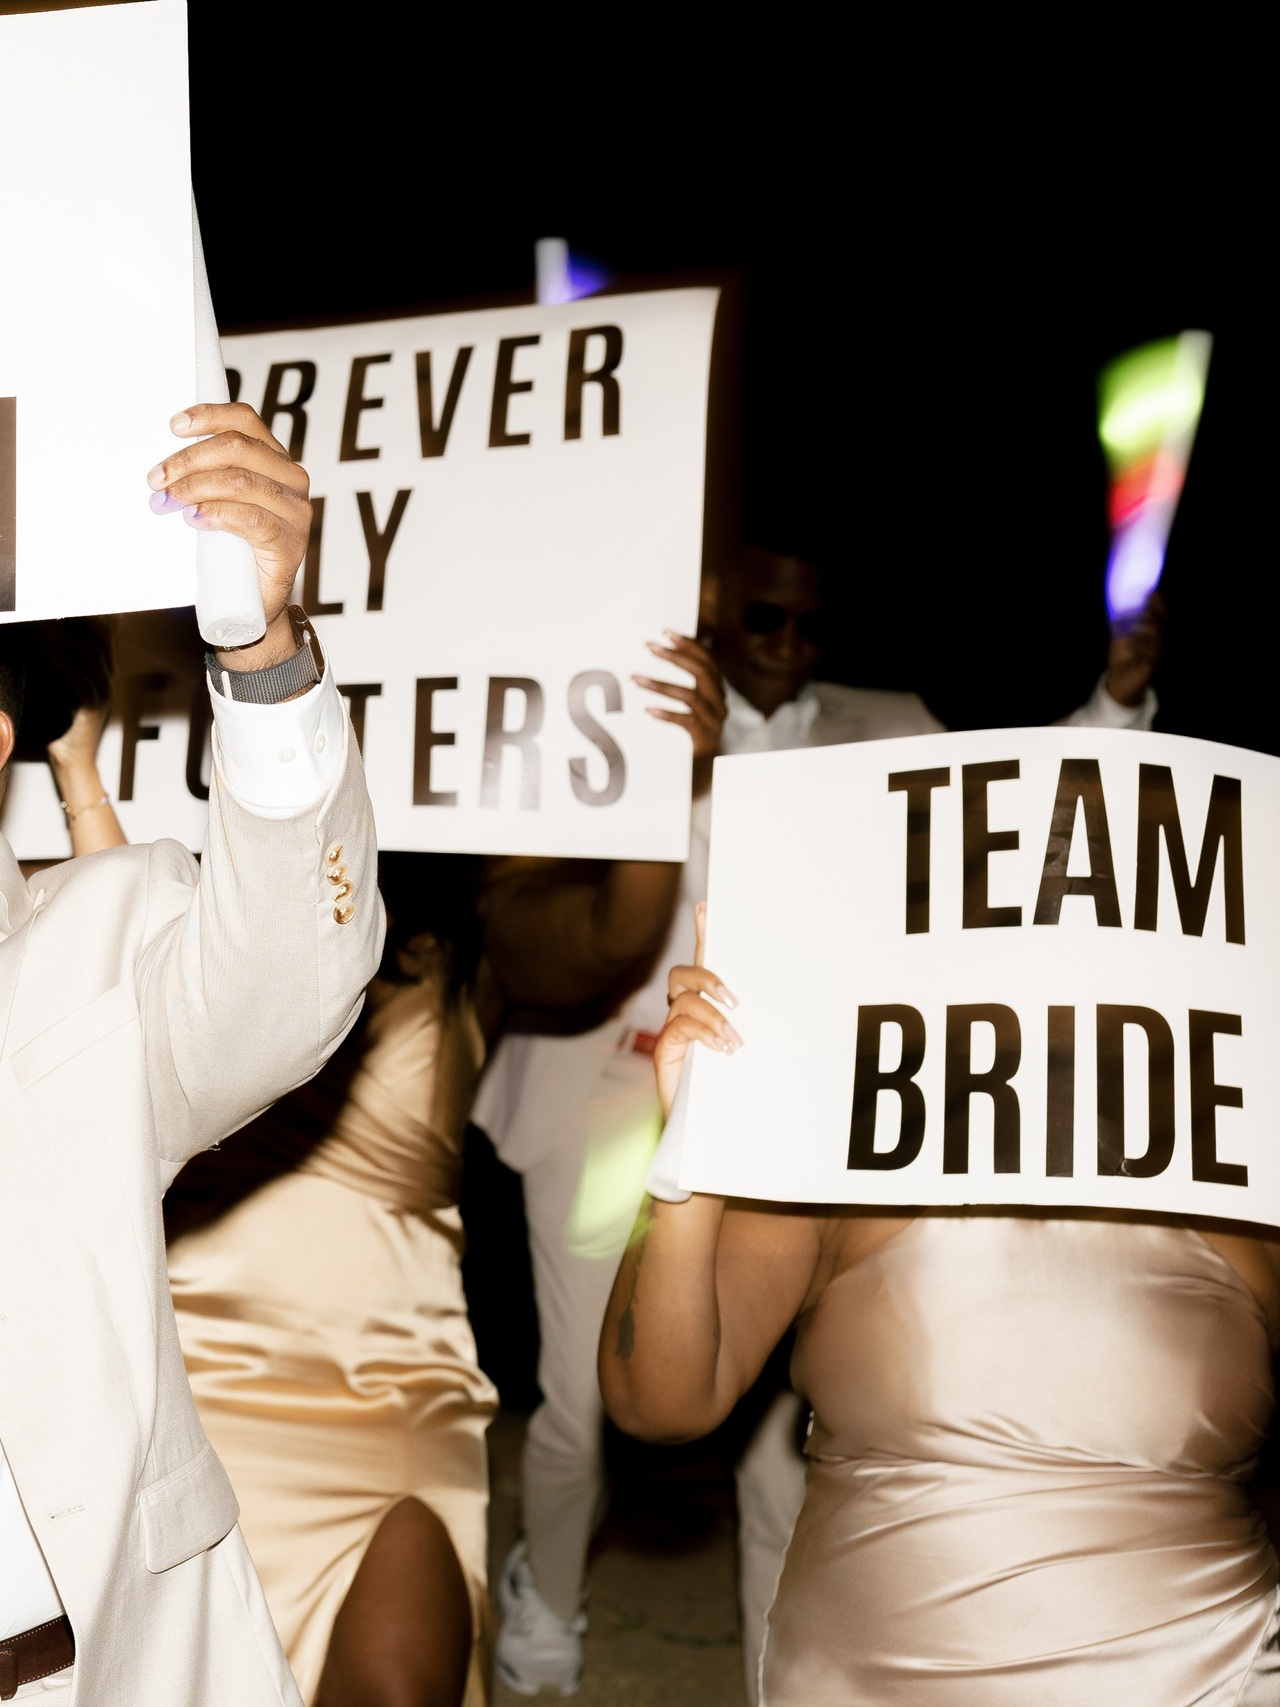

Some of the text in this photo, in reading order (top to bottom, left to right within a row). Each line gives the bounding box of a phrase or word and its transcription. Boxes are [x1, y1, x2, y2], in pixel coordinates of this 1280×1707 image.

[226, 324, 625, 463] REVER
[302, 488, 414, 616] LY
[118, 668, 628, 809] FTERS
[887, 758, 1246, 946] TEAM
[846, 1002, 1249, 1188] BRIDE
